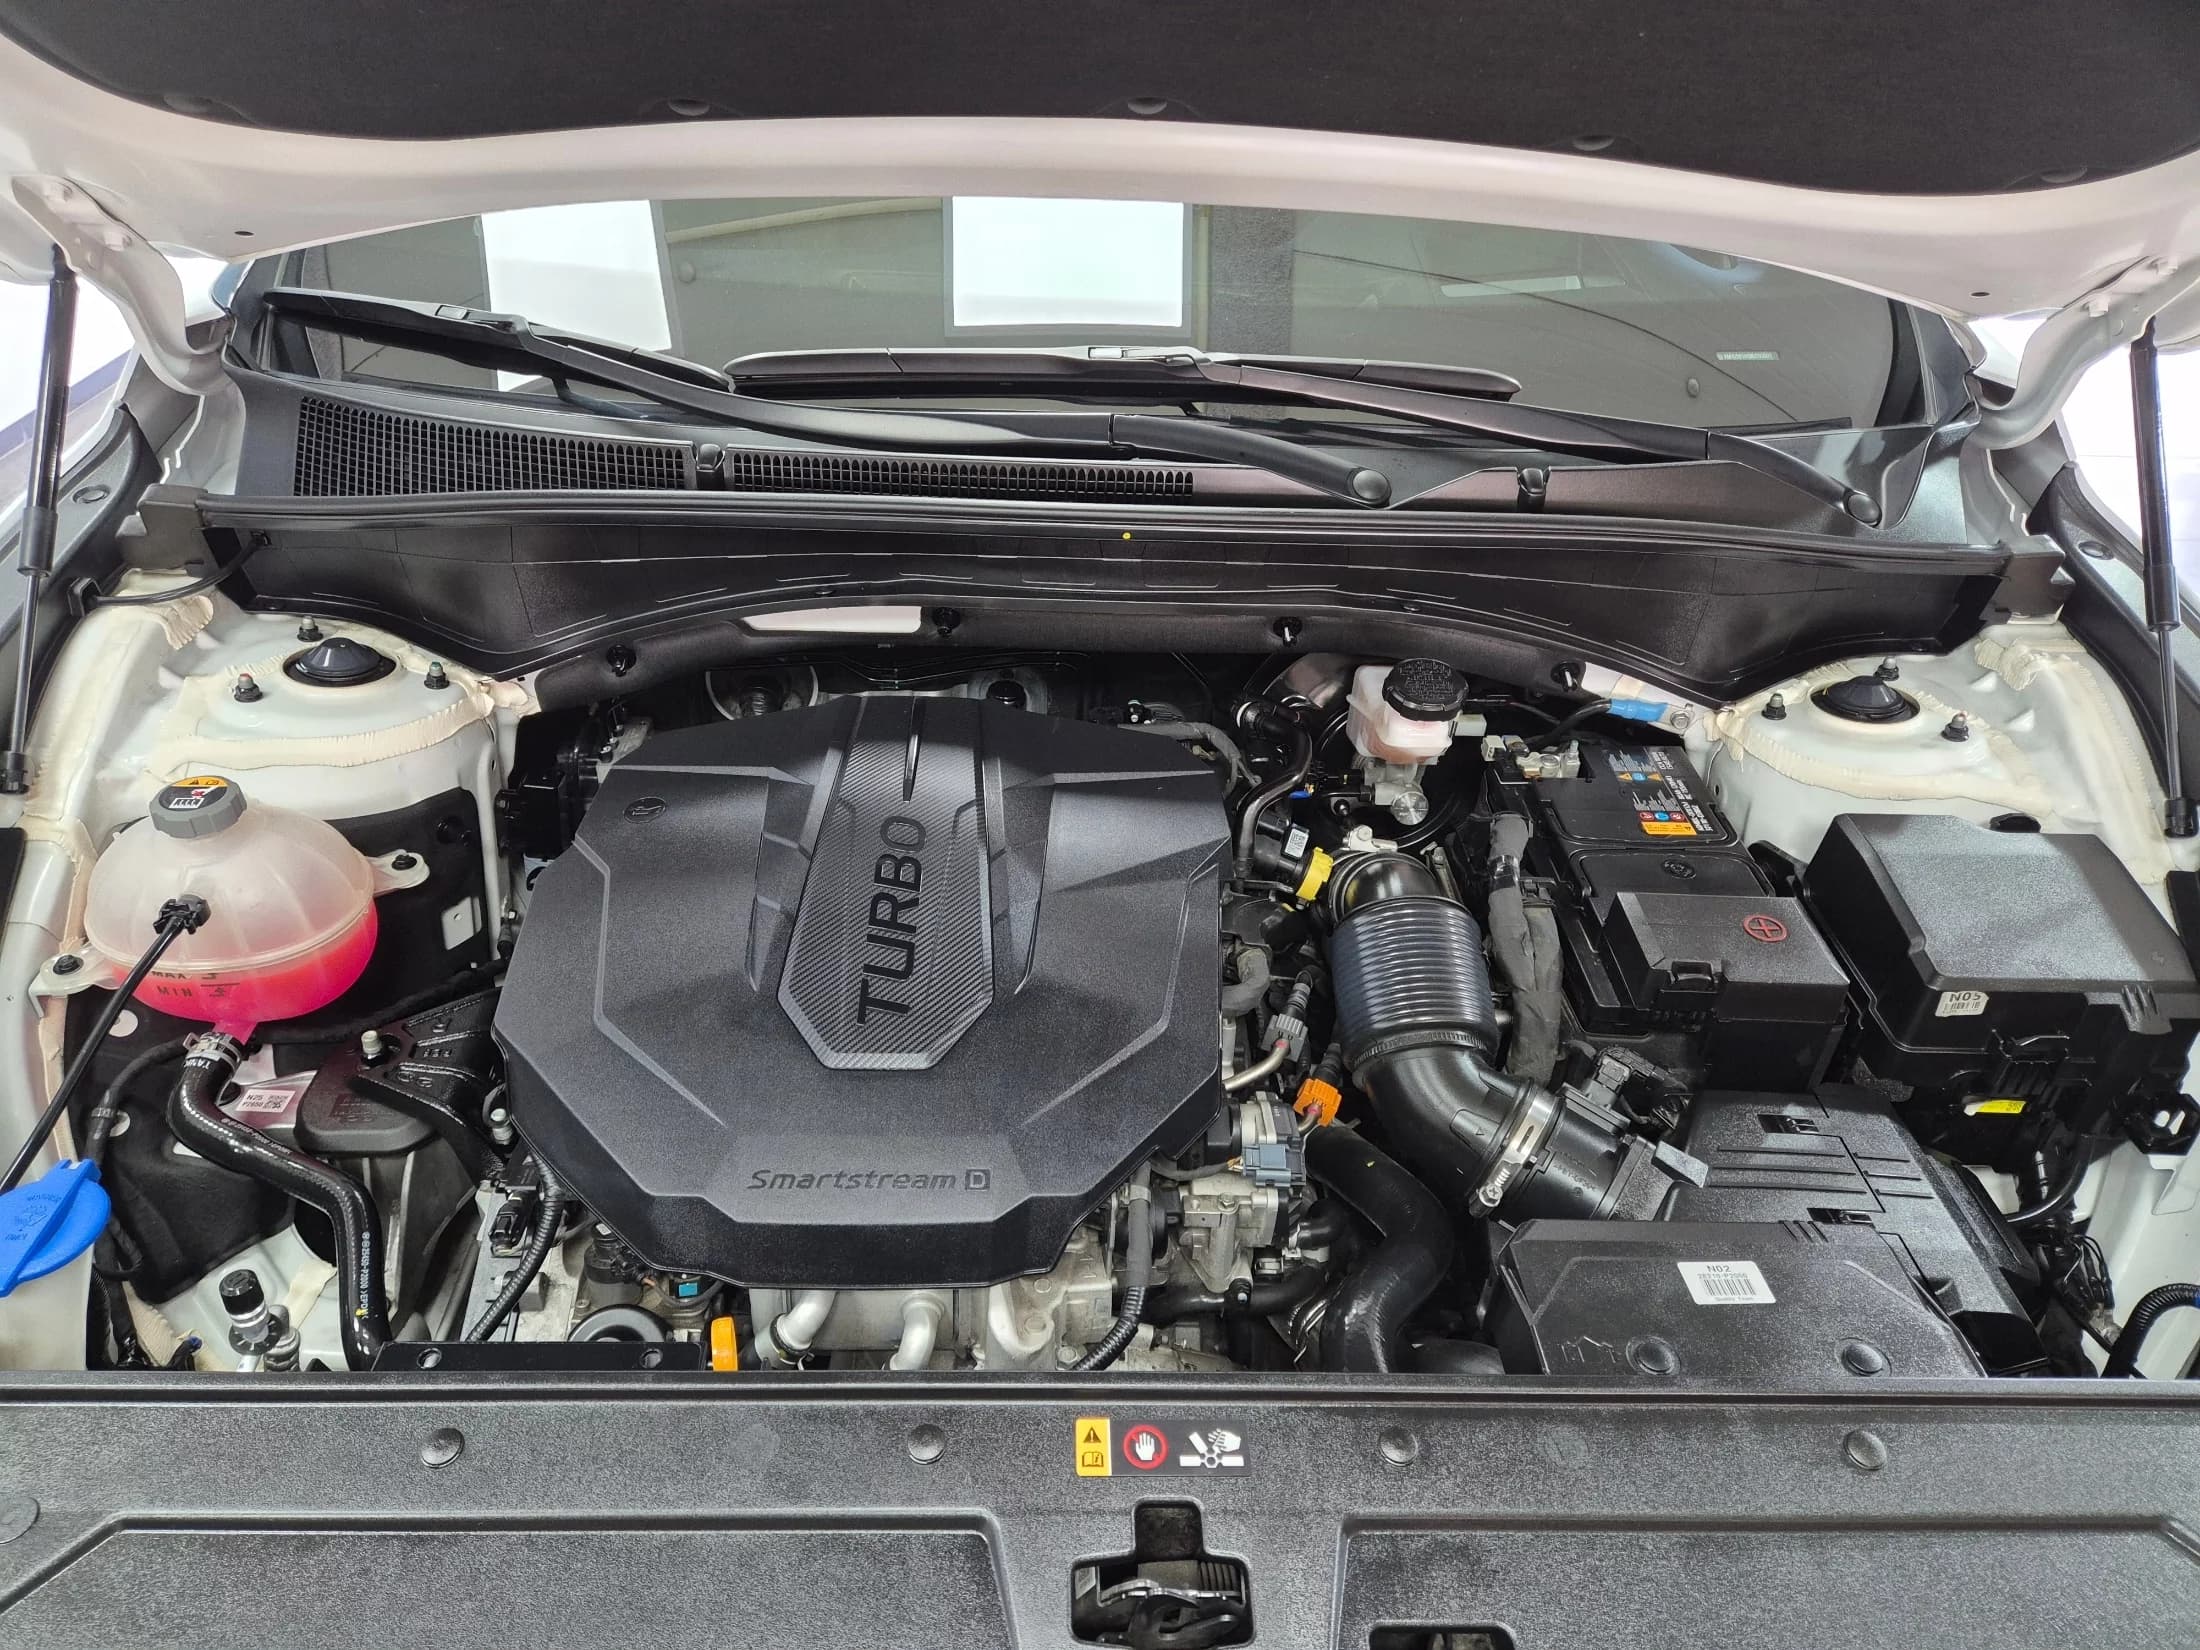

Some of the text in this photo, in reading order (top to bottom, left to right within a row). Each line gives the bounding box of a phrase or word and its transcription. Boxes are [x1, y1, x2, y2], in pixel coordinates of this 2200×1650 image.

[857, 815, 926, 1026] TURBO
[157, 985, 193, 997] MIN
[747, 1169, 989, 1190] Smartstream D
[1706, 1265, 1731, 1273] N02
